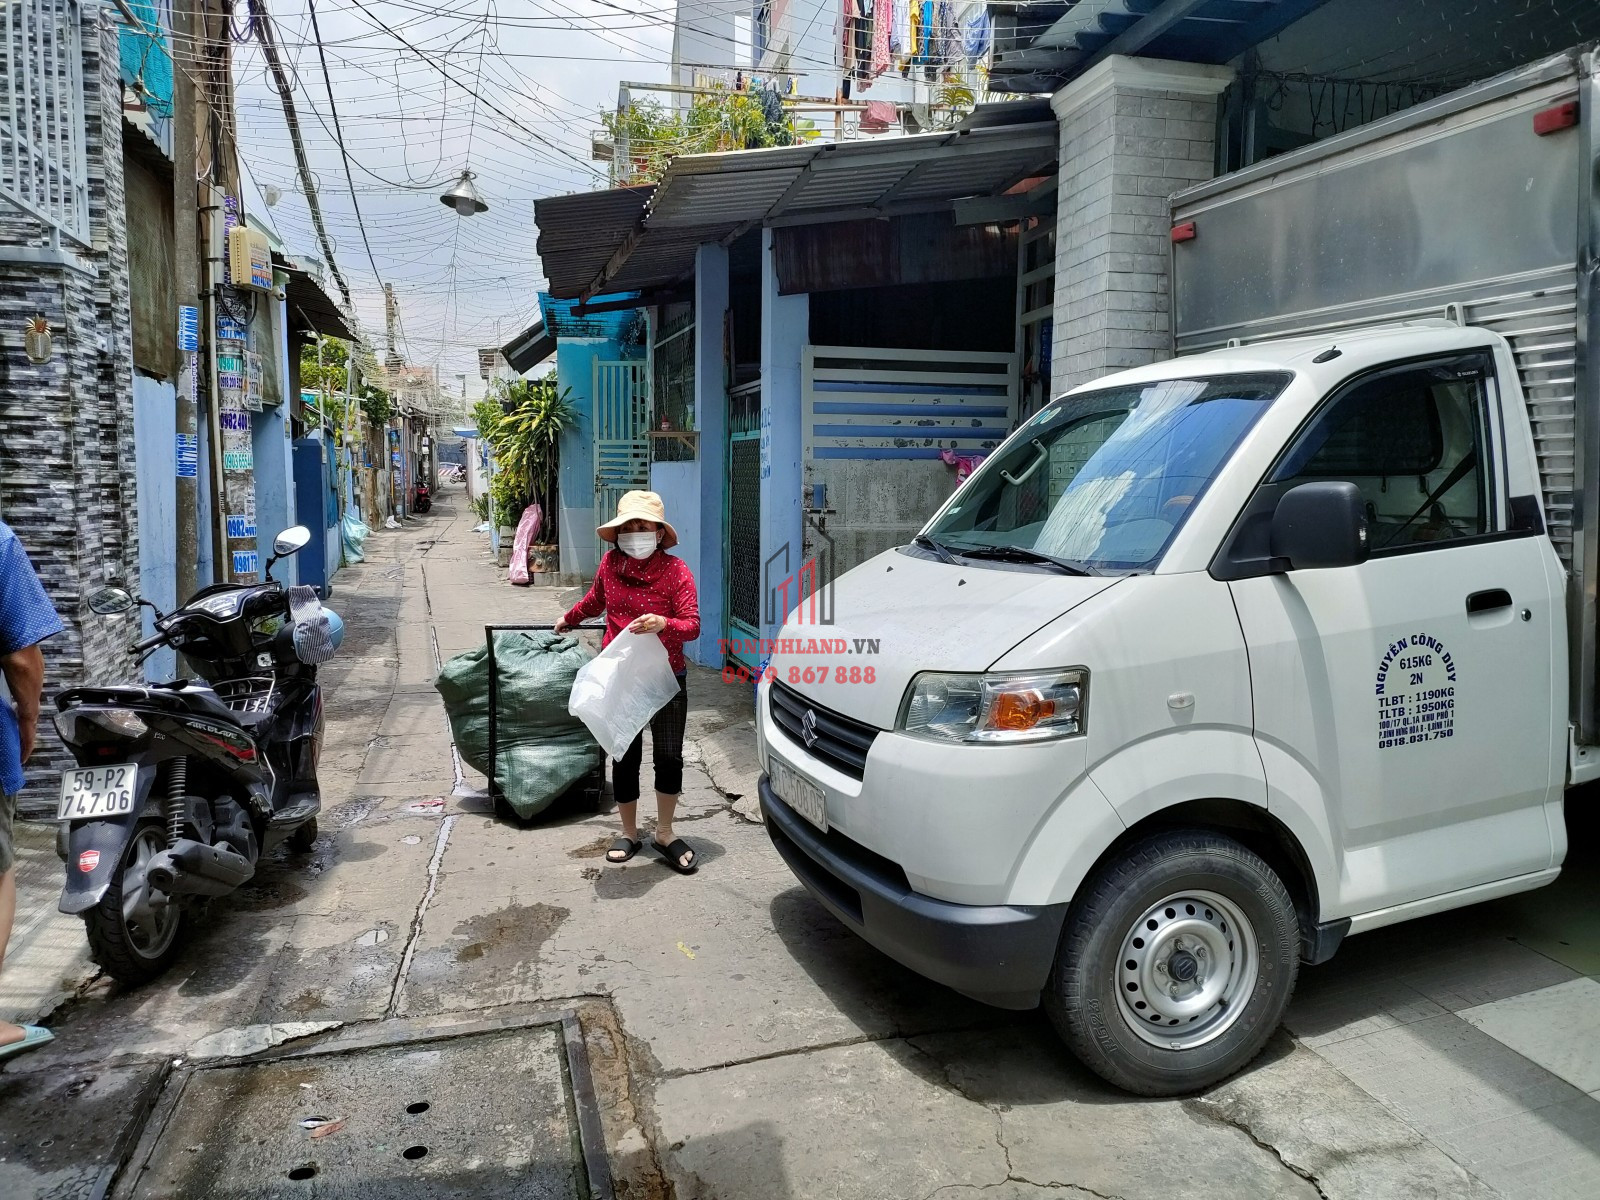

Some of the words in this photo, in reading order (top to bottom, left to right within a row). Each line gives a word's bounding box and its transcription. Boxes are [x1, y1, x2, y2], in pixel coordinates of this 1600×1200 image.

[1400, 654, 1432, 670] 615KG
[1411, 633, 1443, 654] CÔNG
[1442, 652, 1456, 682] DUY
[1410, 672, 1423, 685] 2N
[1378, 695, 1405, 707] TLBT
[1416, 687, 1454, 701] 1190KG
[1378, 707, 1405, 719] TLTB
[1416, 699, 1454, 713] 1950KG
[1378, 729, 1453, 749] 0918.031.750
[73, 768, 126, 792] 59-P2
[63, 790, 130, 817] 747.06
